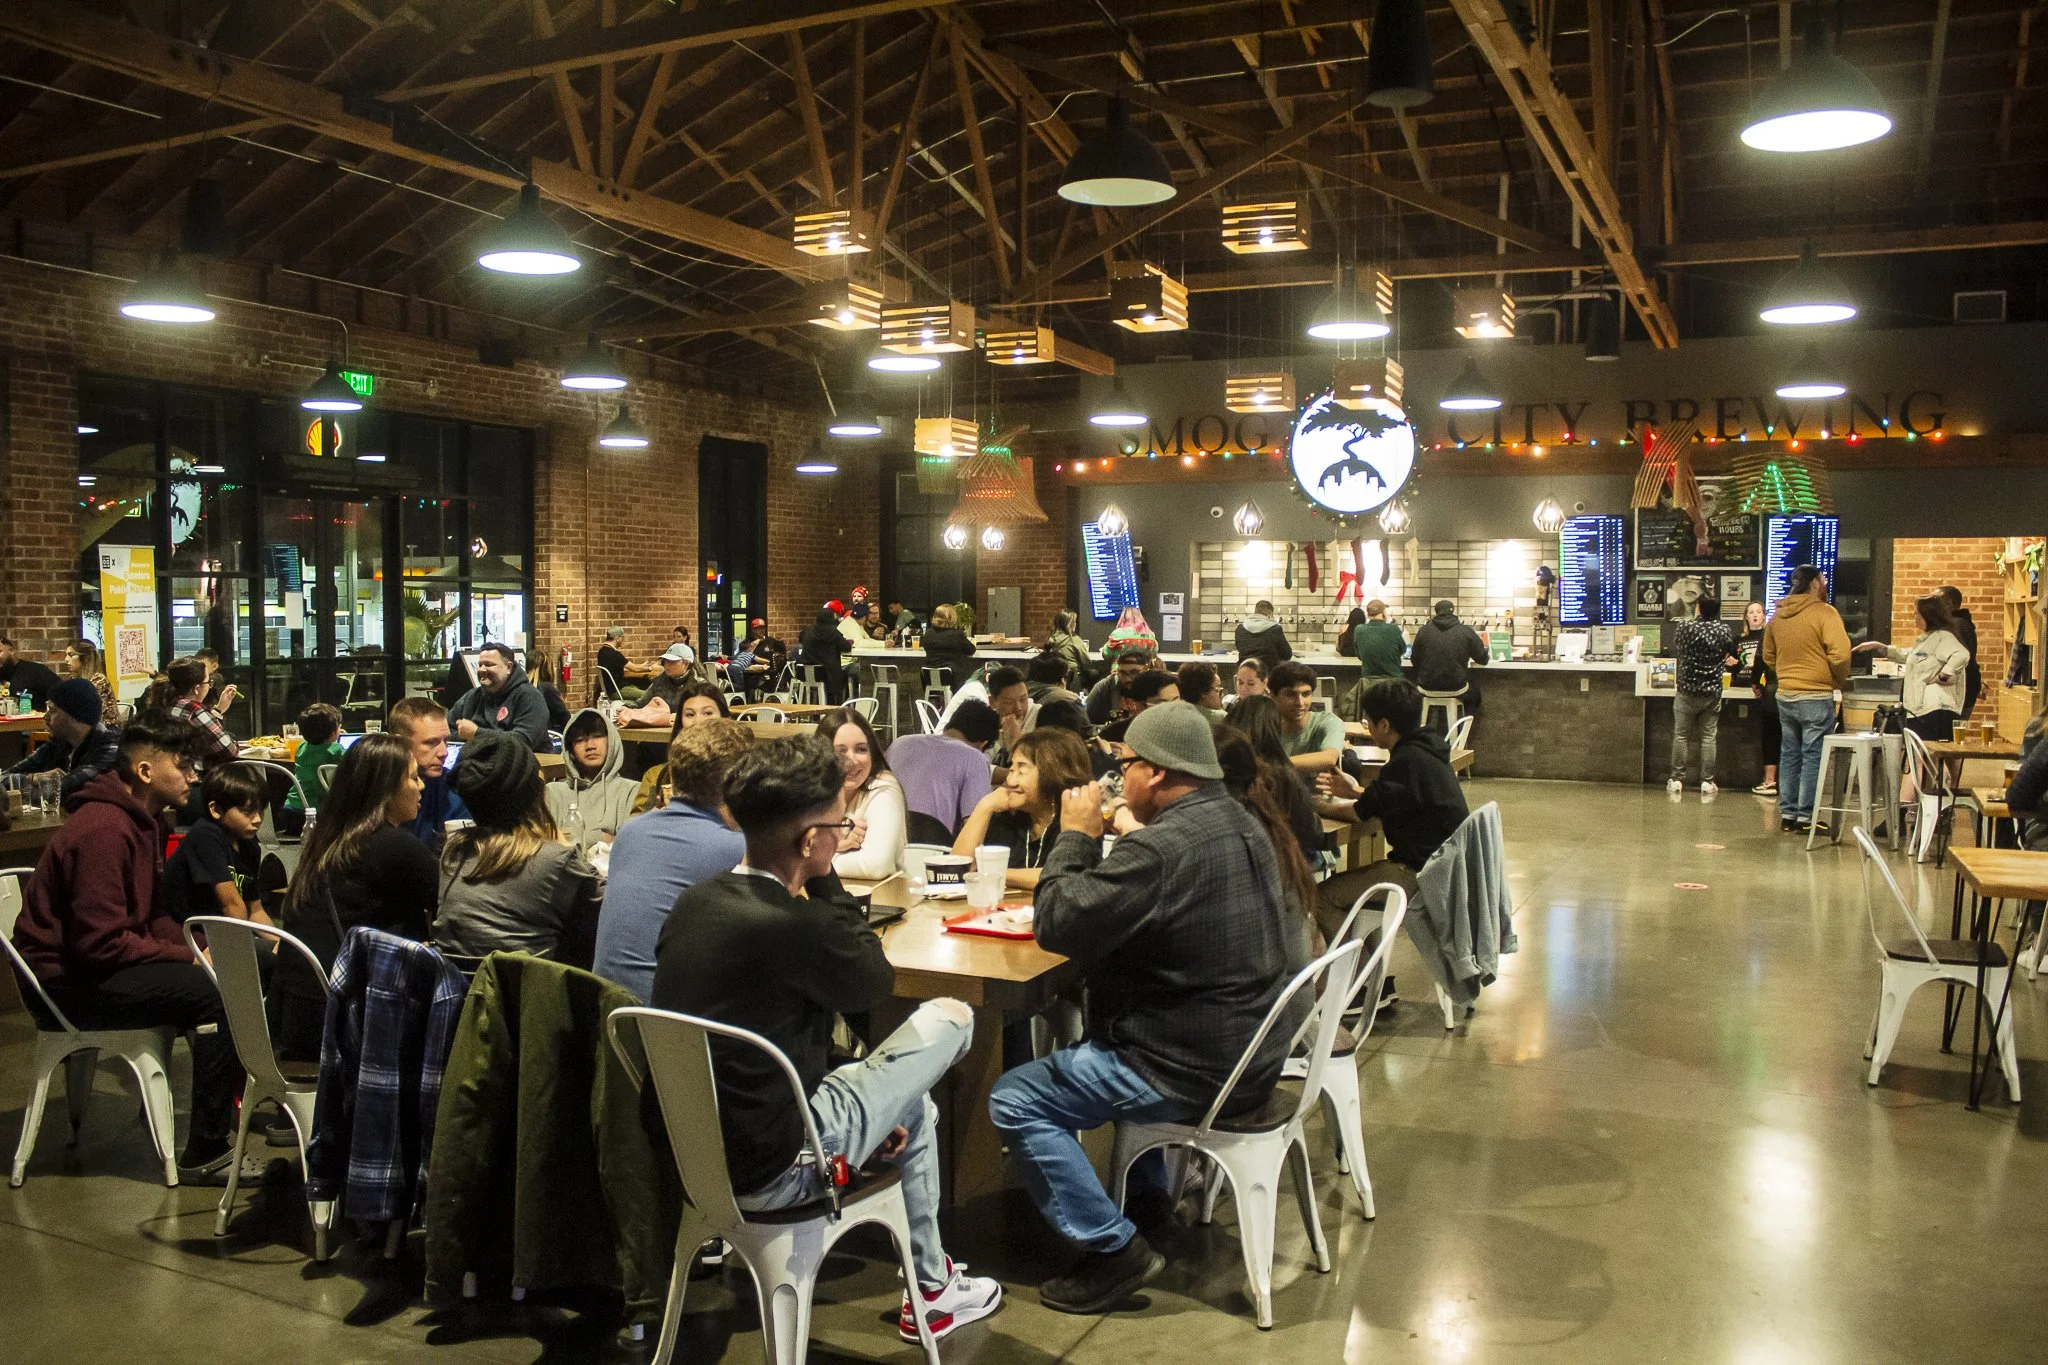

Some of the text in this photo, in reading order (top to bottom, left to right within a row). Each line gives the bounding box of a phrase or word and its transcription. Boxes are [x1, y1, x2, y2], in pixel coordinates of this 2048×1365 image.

[351, 373, 367, 392] EXIT
[1118, 390, 1947, 458] SMOG CITY BREWING
[936, 873, 959, 883] JINYA
